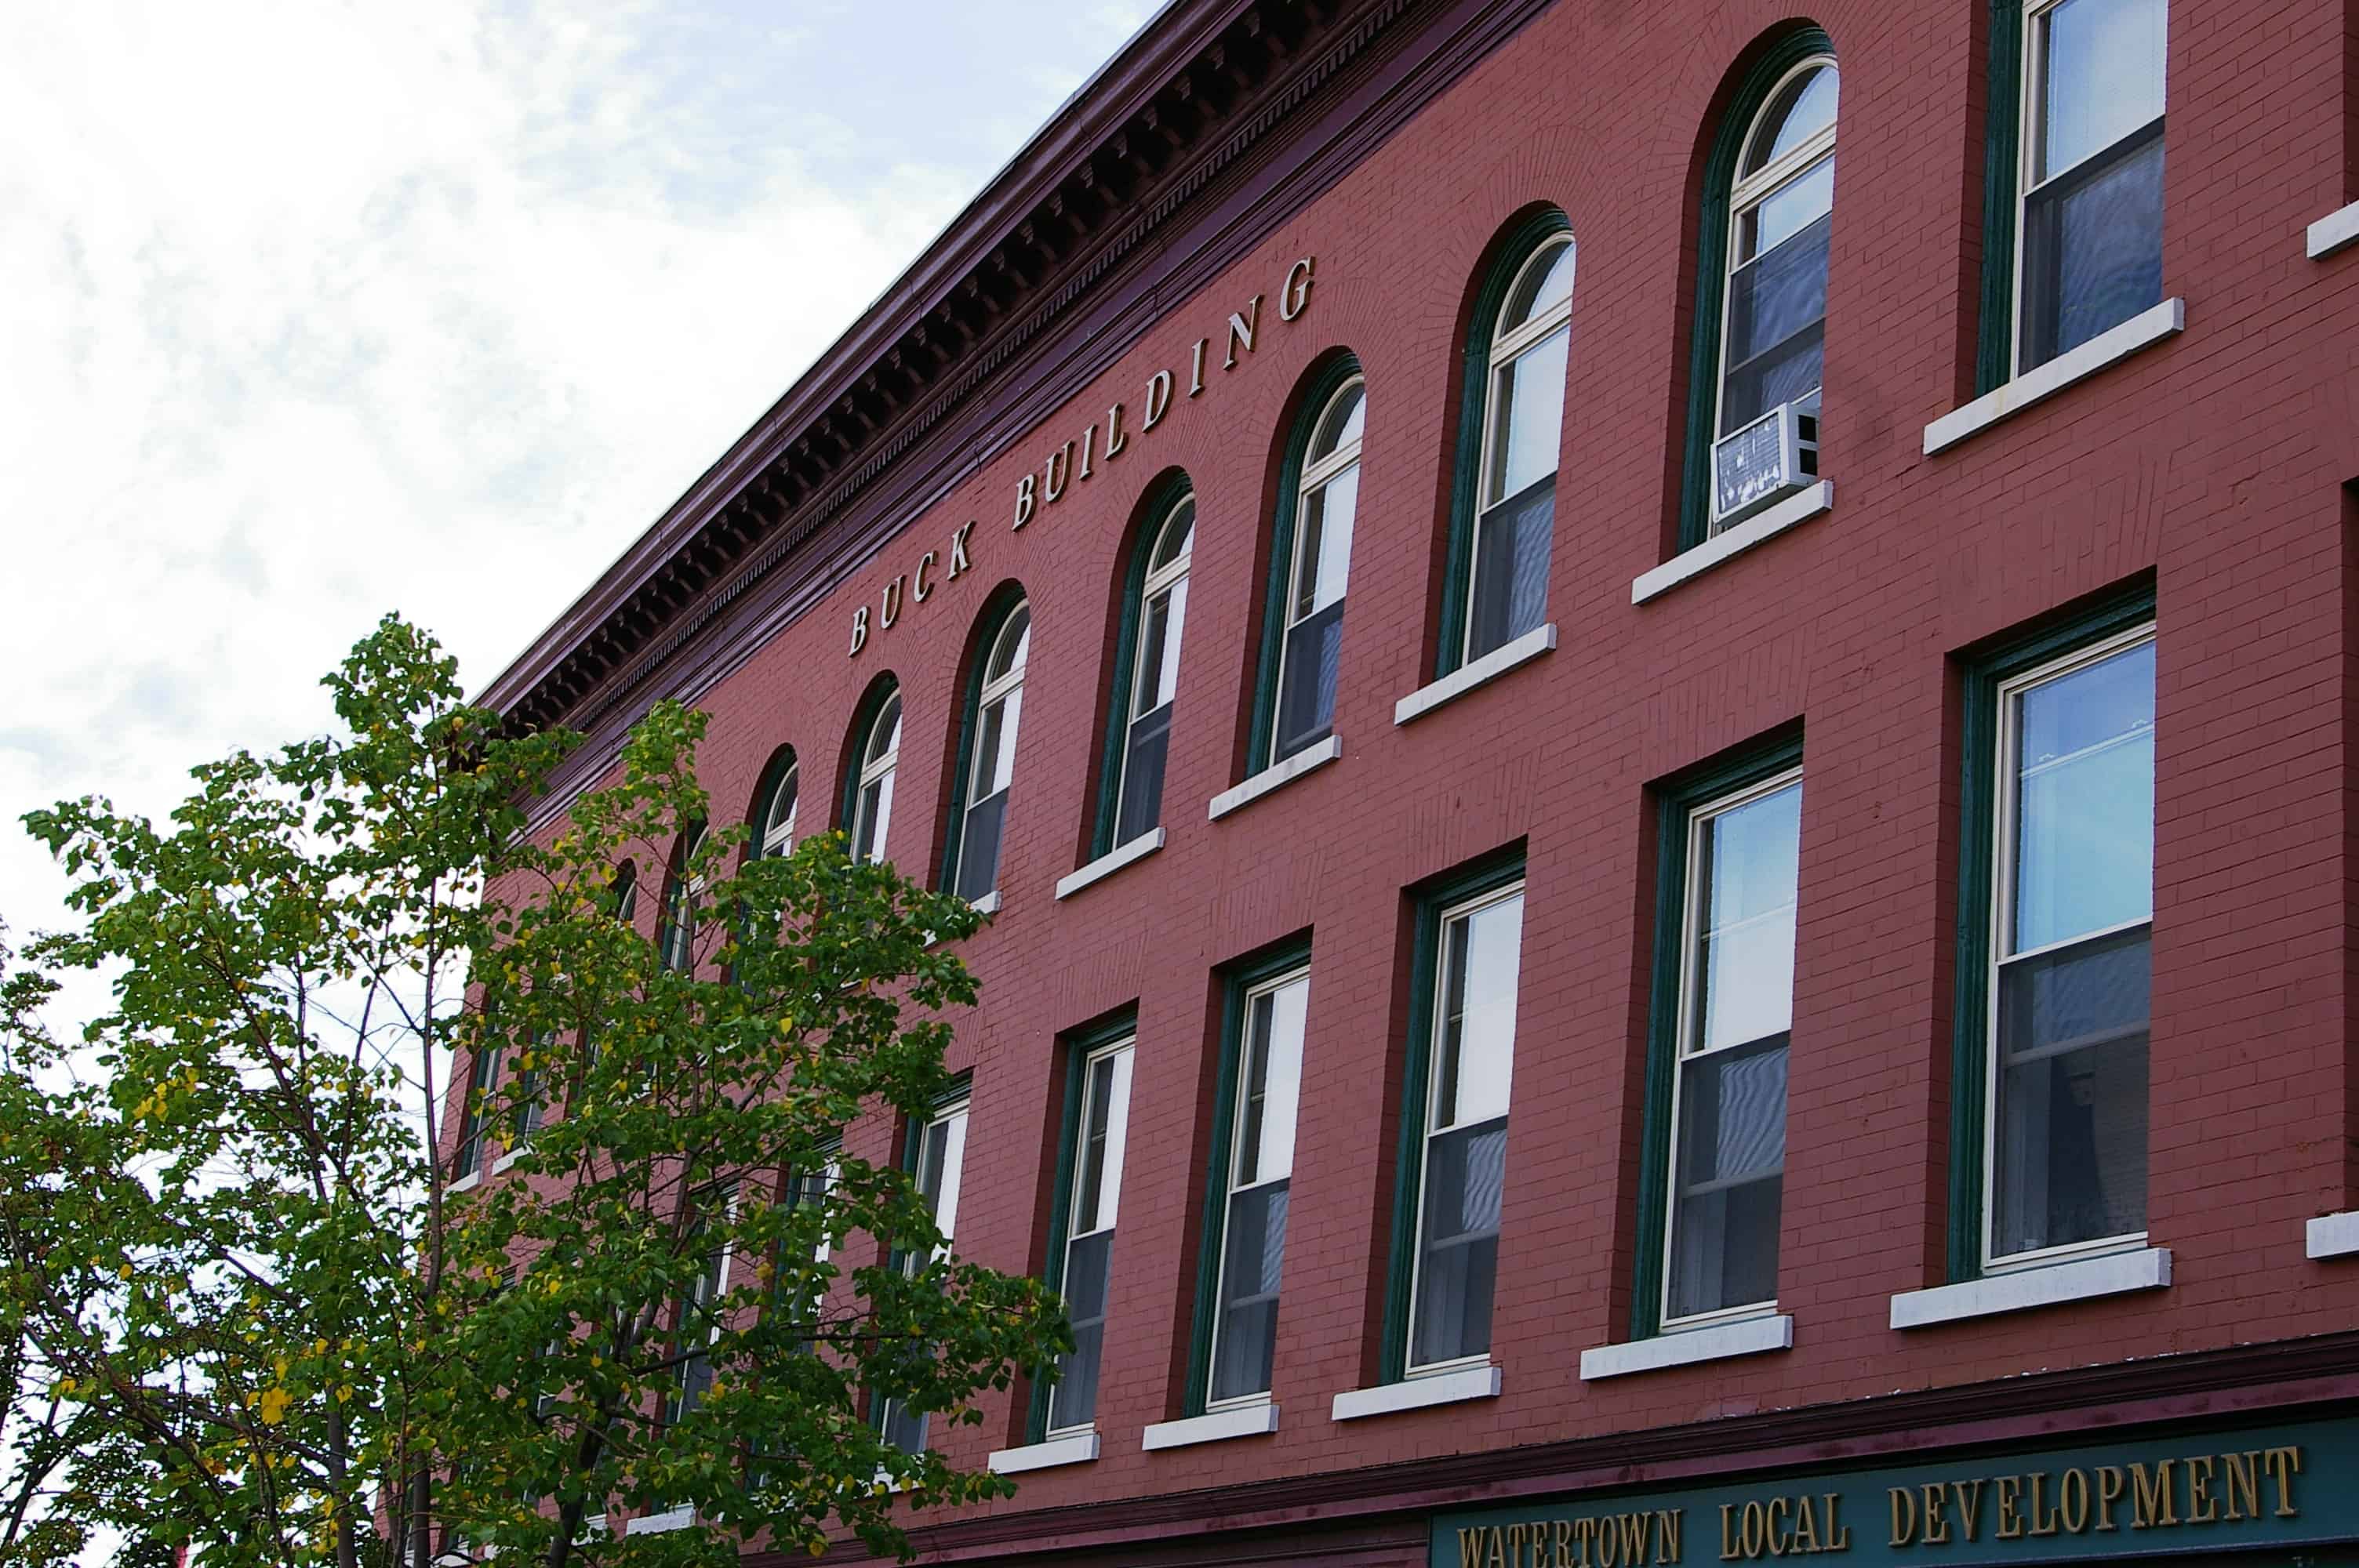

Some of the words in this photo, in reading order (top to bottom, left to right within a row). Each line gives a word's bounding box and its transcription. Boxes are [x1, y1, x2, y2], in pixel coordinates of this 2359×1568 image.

[848, 521, 976, 657] BUCK
[1012, 256, 1315, 532] BUILDING
[1457, 1508, 1683, 1568] WATERTOWN
[1719, 1493, 1850, 1560] LOCAL
[1888, 1446, 2303, 1547] DEVELOPMENT
